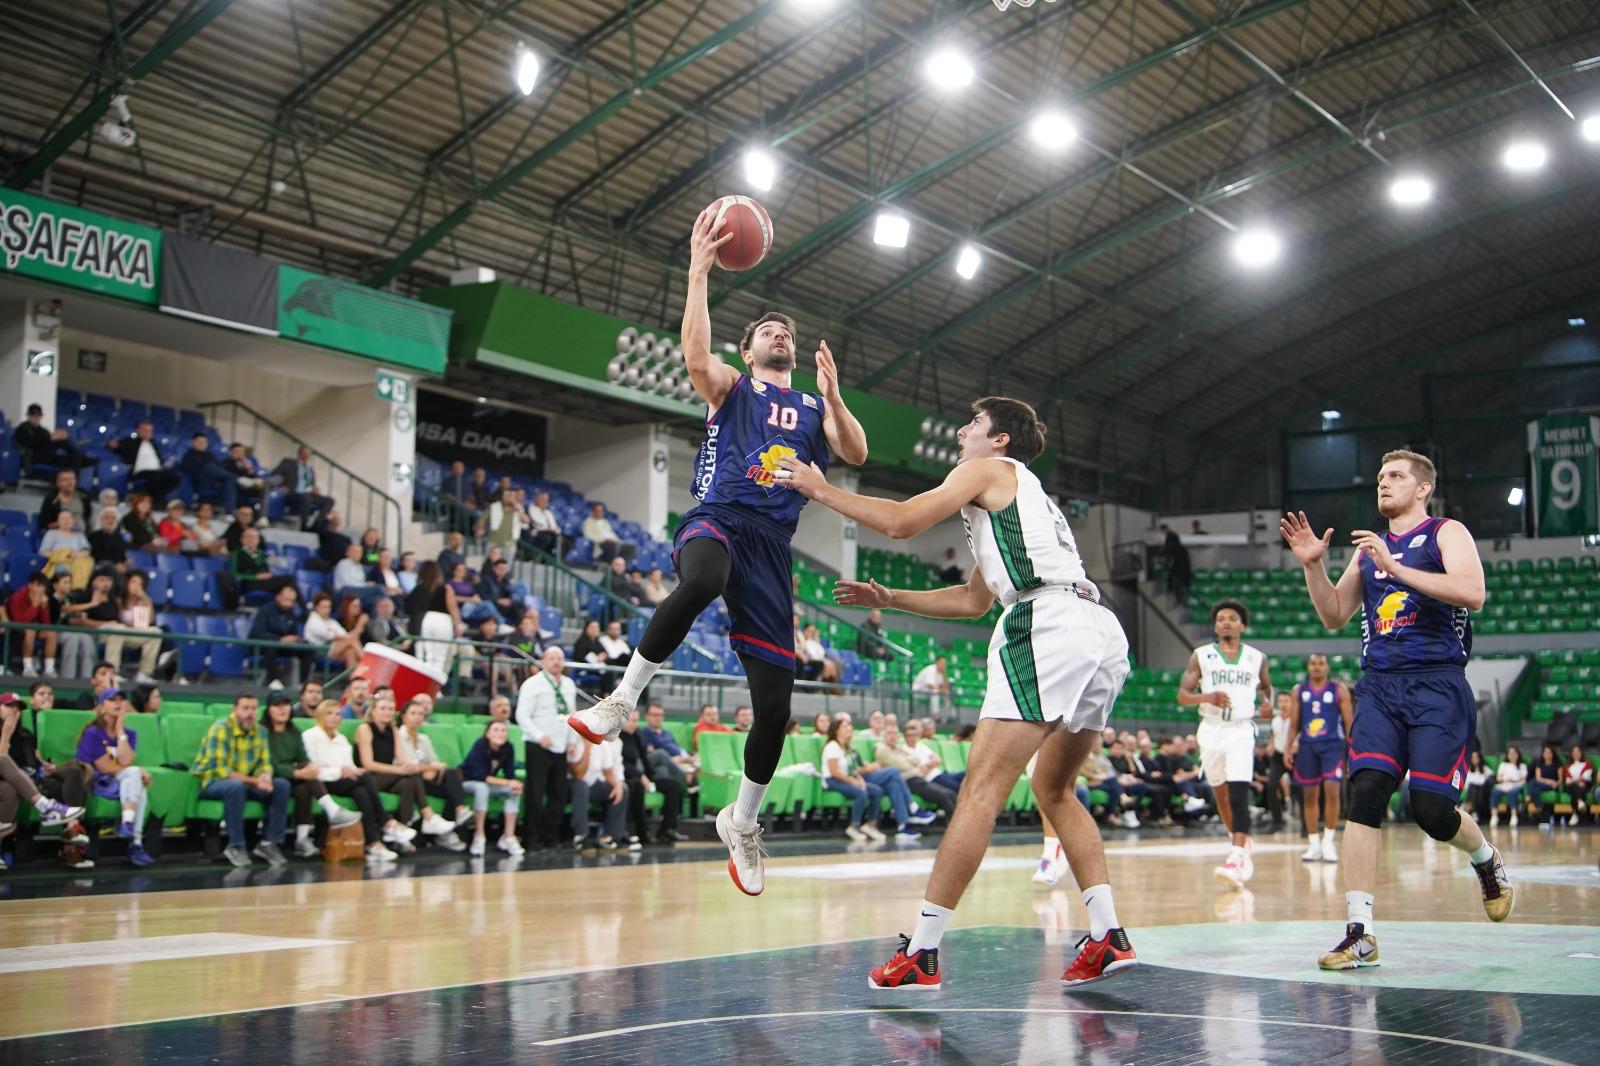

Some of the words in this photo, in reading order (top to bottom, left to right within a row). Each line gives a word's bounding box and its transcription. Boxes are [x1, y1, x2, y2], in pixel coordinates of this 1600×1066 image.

[0, 201, 155, 289] ŞAFAKA
[766, 402, 798, 431] 10
[1551, 458, 1581, 509] 9
